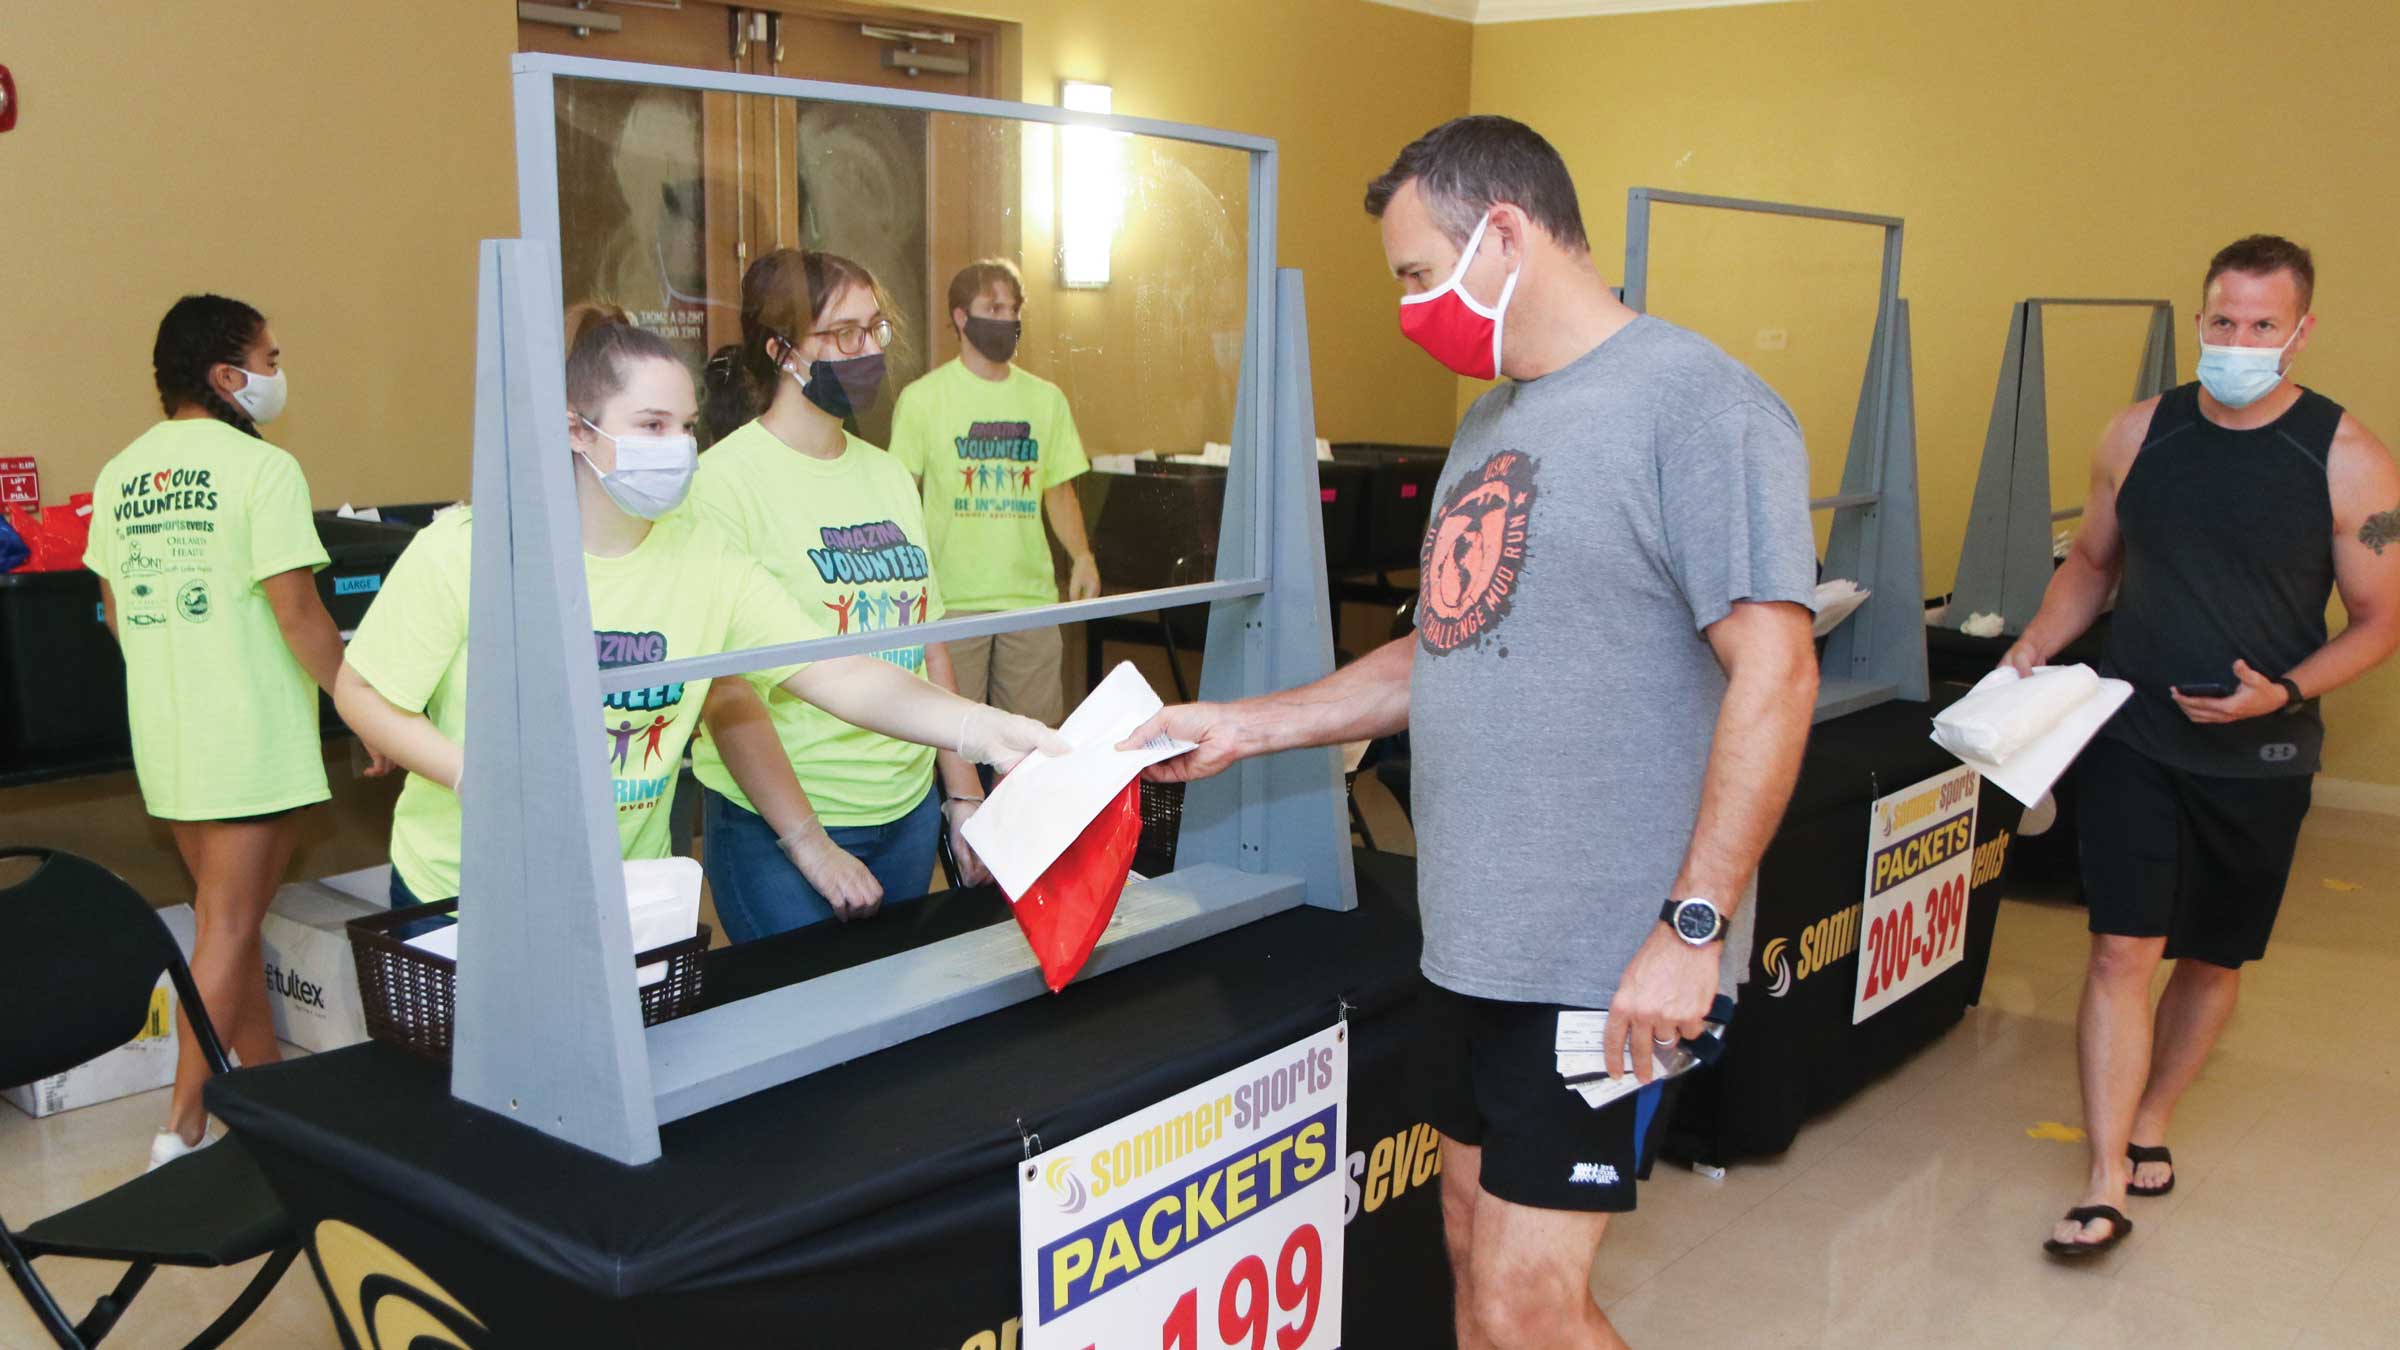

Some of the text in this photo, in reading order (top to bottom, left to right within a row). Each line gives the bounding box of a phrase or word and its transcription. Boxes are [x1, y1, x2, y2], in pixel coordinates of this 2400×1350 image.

[955, 436, 1038, 462] VOLUNTEER
[121, 468, 211, 499] WE OUR
[1484, 454, 1516, 481] USMC
[113, 489, 218, 522] VOLUNTEERS
[954, 498, 968, 510] BE
[1503, 513, 1526, 560] RUN
[342, 578, 372, 591] LARGE
[1484, 566, 1515, 612] MUD
[1423, 604, 1487, 649] CHALLENGE
[595, 632, 666, 664] ZING
[620, 800, 655, 812] even
[1875, 816, 1969, 891] PACKETS
[1862, 873, 1965, 1002] 200-399
[274, 967, 325, 1009] tultex
[1052, 1121, 1326, 1312] PACKETS
